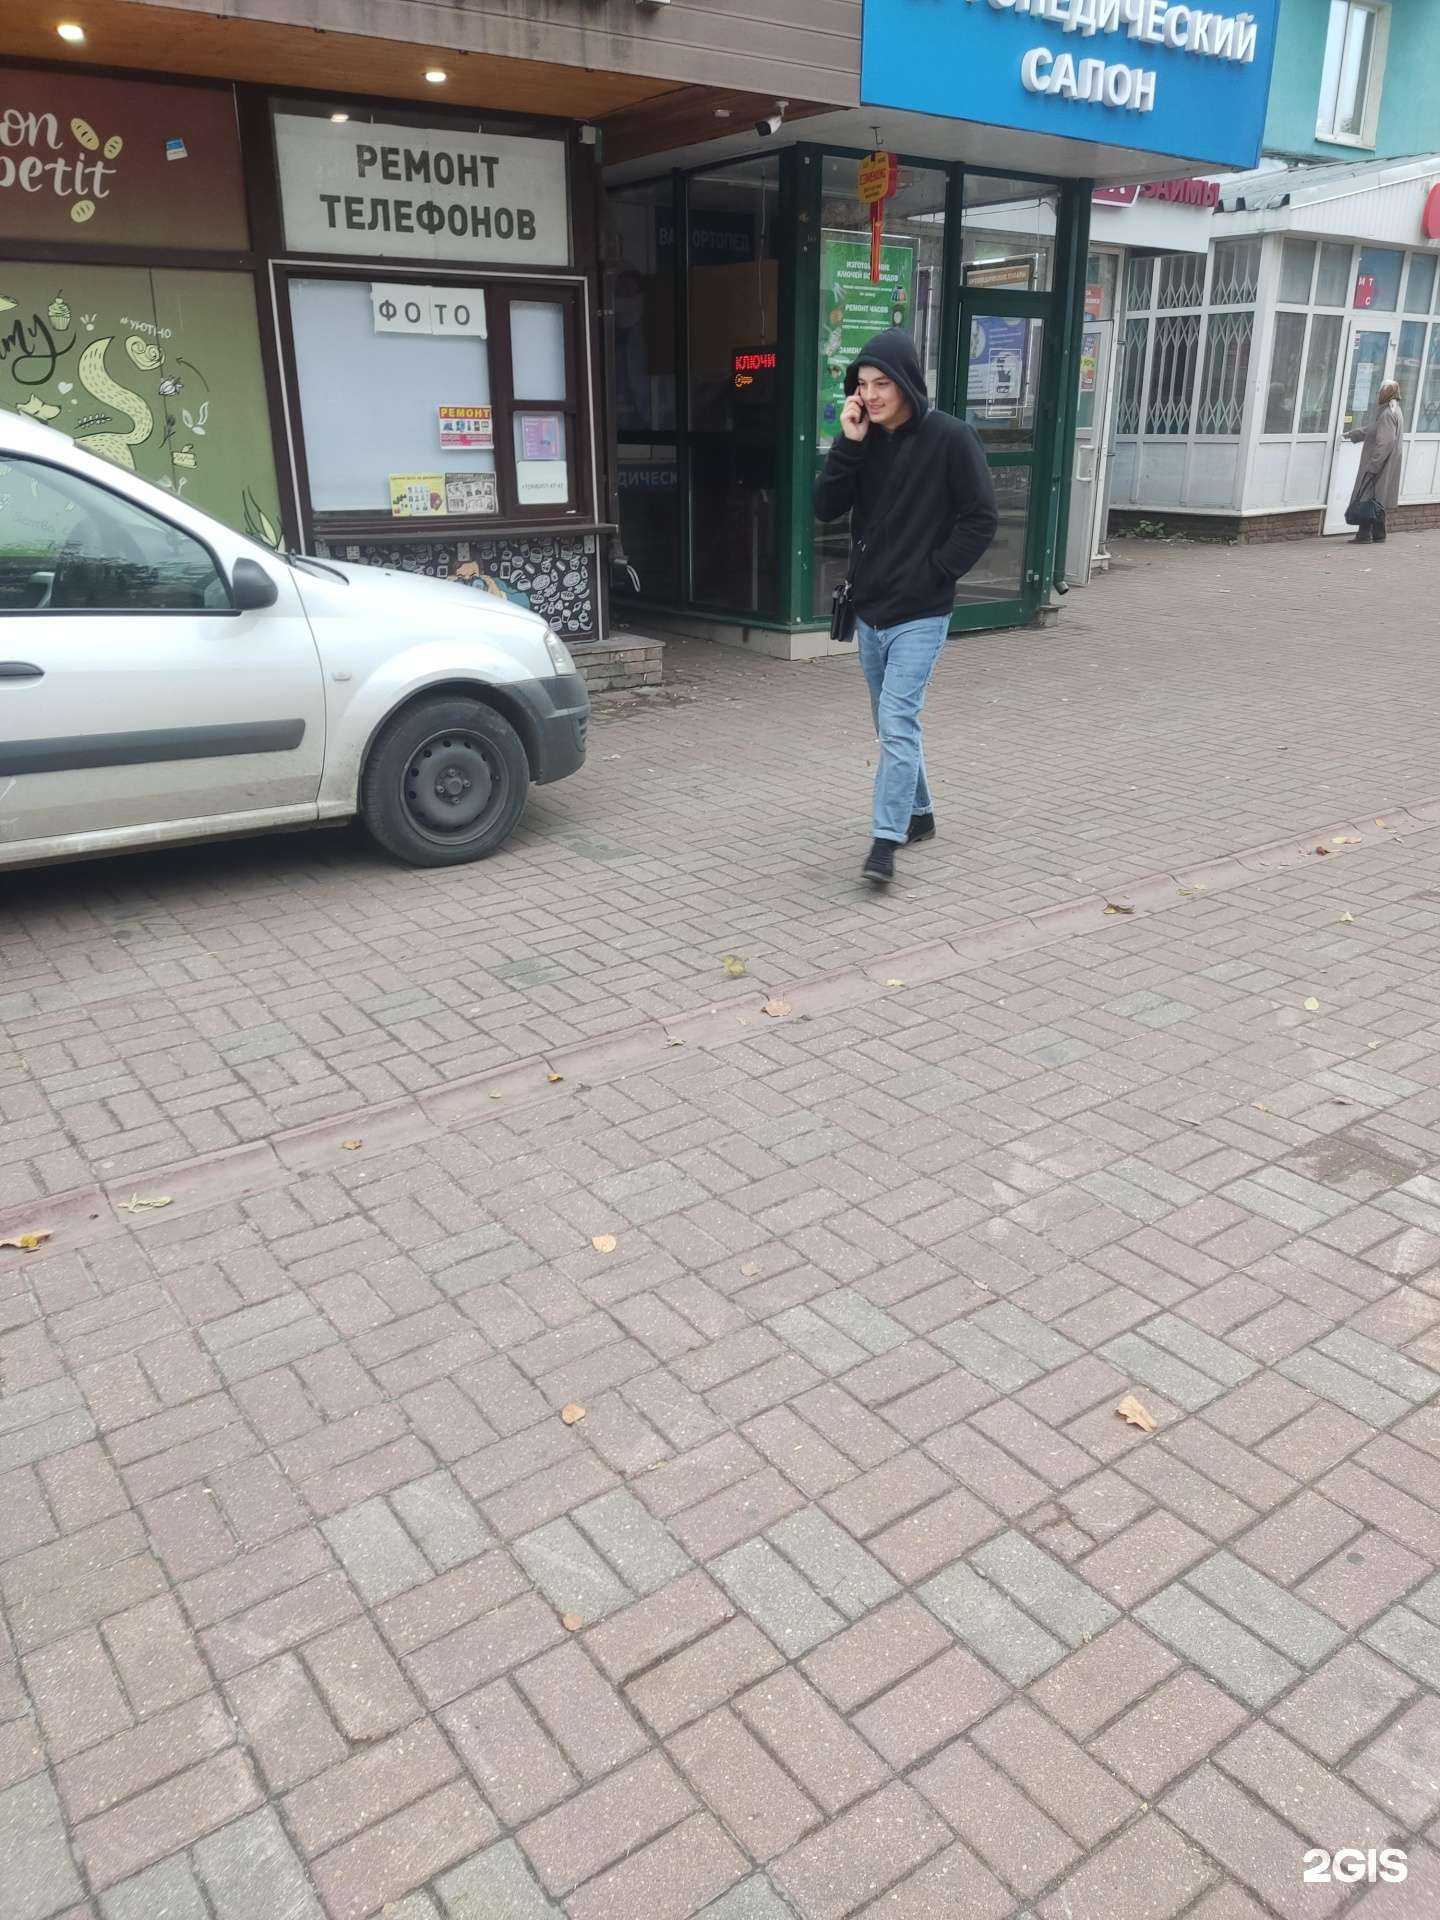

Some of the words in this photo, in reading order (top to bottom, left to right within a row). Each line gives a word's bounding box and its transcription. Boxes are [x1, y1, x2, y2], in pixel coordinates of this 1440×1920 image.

[966, 0, 1258, 64] ДИЧЕСКИЙ
[356, 144, 499, 188] РЕМОНТ
[320, 194, 536, 241] ТЕЛЕФОНОВ
[378, 299, 470, 326] ФОТО
[845, 304, 869, 313] РЕМОНТ
[735, 354, 776, 370] КЛЮЧИ
[440, 408, 491, 418] РЕМОНТ
